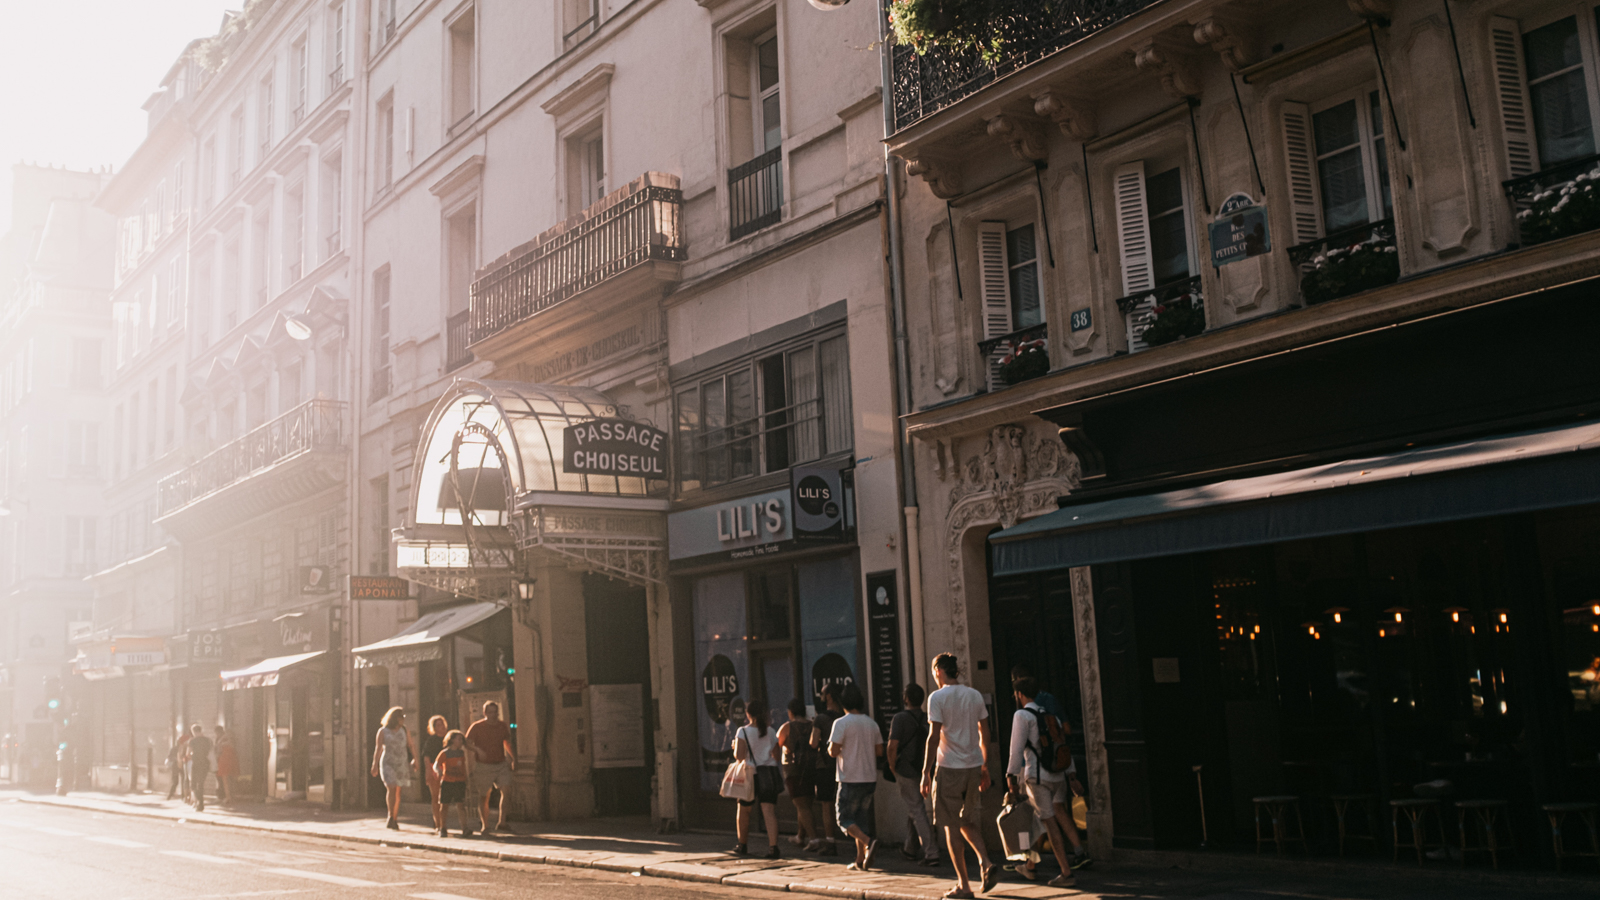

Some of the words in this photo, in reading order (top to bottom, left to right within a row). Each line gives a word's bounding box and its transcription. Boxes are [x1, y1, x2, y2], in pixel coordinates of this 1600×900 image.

[1232, 231, 1245, 242] DES
[1215, 245, 1238, 258] PETITS
[1073, 311, 1088, 329] 38
[574, 422, 664, 452] PASSAGE
[573, 450, 663, 474] CHOISEUL
[798, 487, 830, 499] LILI'S
[554, 515, 602, 531] PASSAGE
[716, 498, 783, 542] LILI'S
[352, 588, 407, 598] JAPONAIS
[193, 633, 222, 645] JOS
[193, 645, 223, 657] EPH
[703, 675, 737, 694] LILI'S
